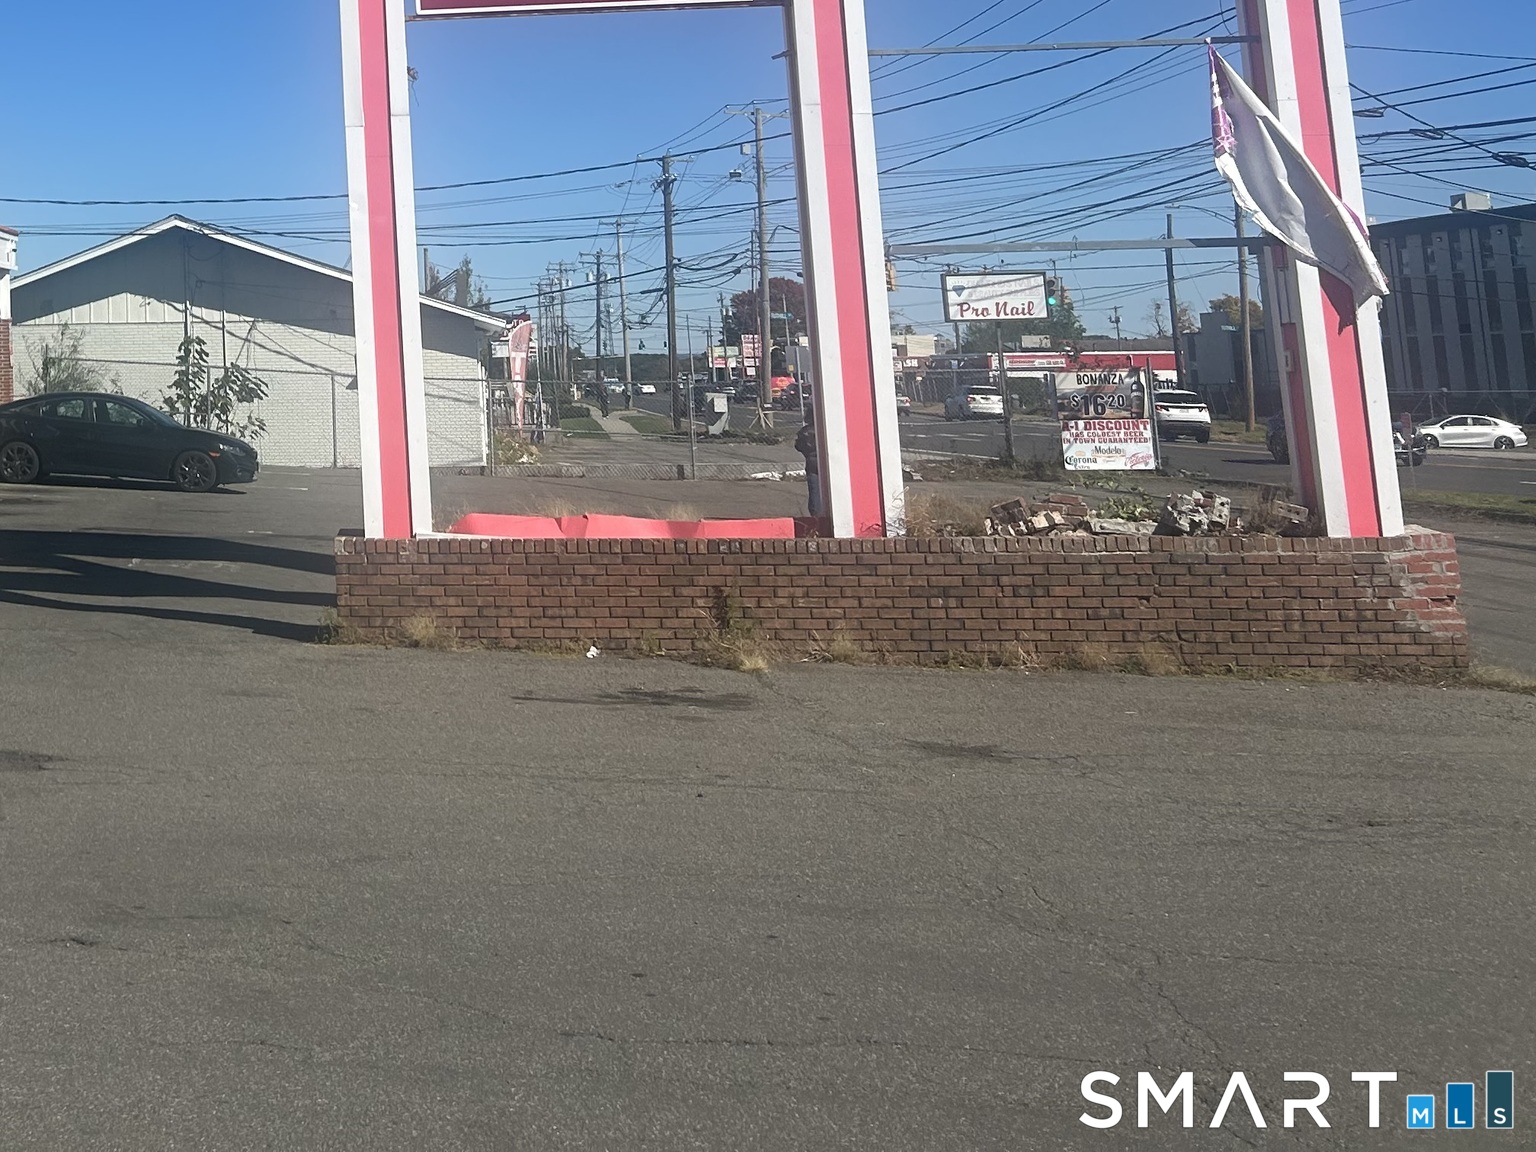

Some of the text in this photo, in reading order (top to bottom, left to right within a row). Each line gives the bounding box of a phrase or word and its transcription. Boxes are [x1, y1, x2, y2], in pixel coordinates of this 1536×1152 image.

[957, 301, 1035, 318] Pro Nail
[1076, 373, 1125, 385] BONANZA
[1083, 420, 1149, 431] DISCOUNT
[1094, 445, 1122, 455] Modelo
[1065, 455, 1098, 465] Corona
